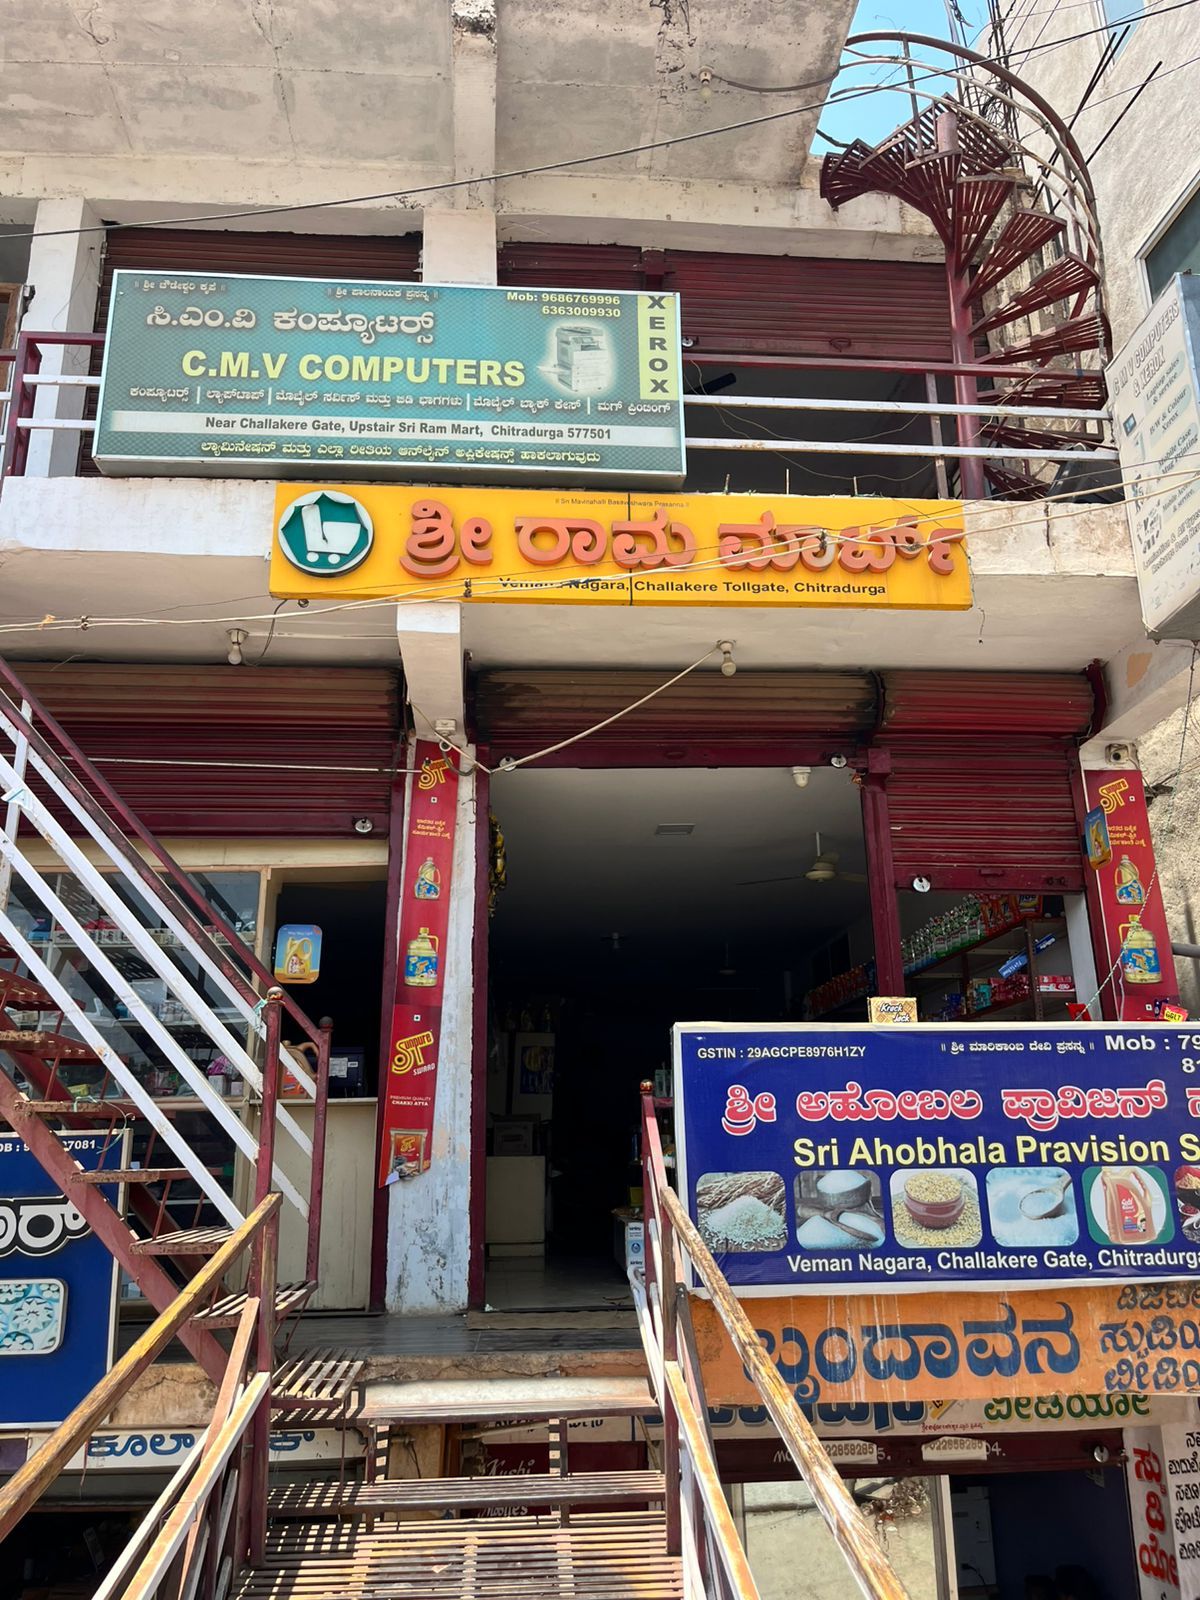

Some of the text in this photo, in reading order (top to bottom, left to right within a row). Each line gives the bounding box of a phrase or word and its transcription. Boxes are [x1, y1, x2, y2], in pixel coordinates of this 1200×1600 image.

[507, 291, 621, 305] Mob: 9686769996
[541, 305, 621, 318] 6363009930
[146, 305, 435, 344] ಸಿ.ಎಂ.ವಿ ಕಂಪ್ಯೂಟರ್ಸ್
[1135, 300, 1179, 368] COMPUTERS
[647, 295, 670, 394] XEROX
[182, 350, 526, 387] C.M.V COMPUTERS
[205, 417, 611, 440] Near Challakere Gate, Upstair Sri Ram Mart, Chitradurga 577501
[400, 499, 493, 579] ಶ್ರೀ
[514, 508, 697, 569] ರಾಮ
[634, 580, 718, 592] Challakere
[722, 581, 789, 594] Tollgate,
[794, 582, 886, 596] Chitradurga
[697, 1047, 737, 1059] GSTIN
[747, 1046, 866, 1058] 29AGCPE8976H1ZY
[1105, 1035, 1156, 1050] Mob
[722, 1084, 777, 1136] ಶ್ರೀ
[793, 1137, 840, 1167] Sri
[848, 1136, 1007, 1166] Ahobhala
[1016, 1134, 1170, 1164] Pravision
[787, 1248, 1200, 1274] Veman Nagara, Challakere Gate, Chitradurg
